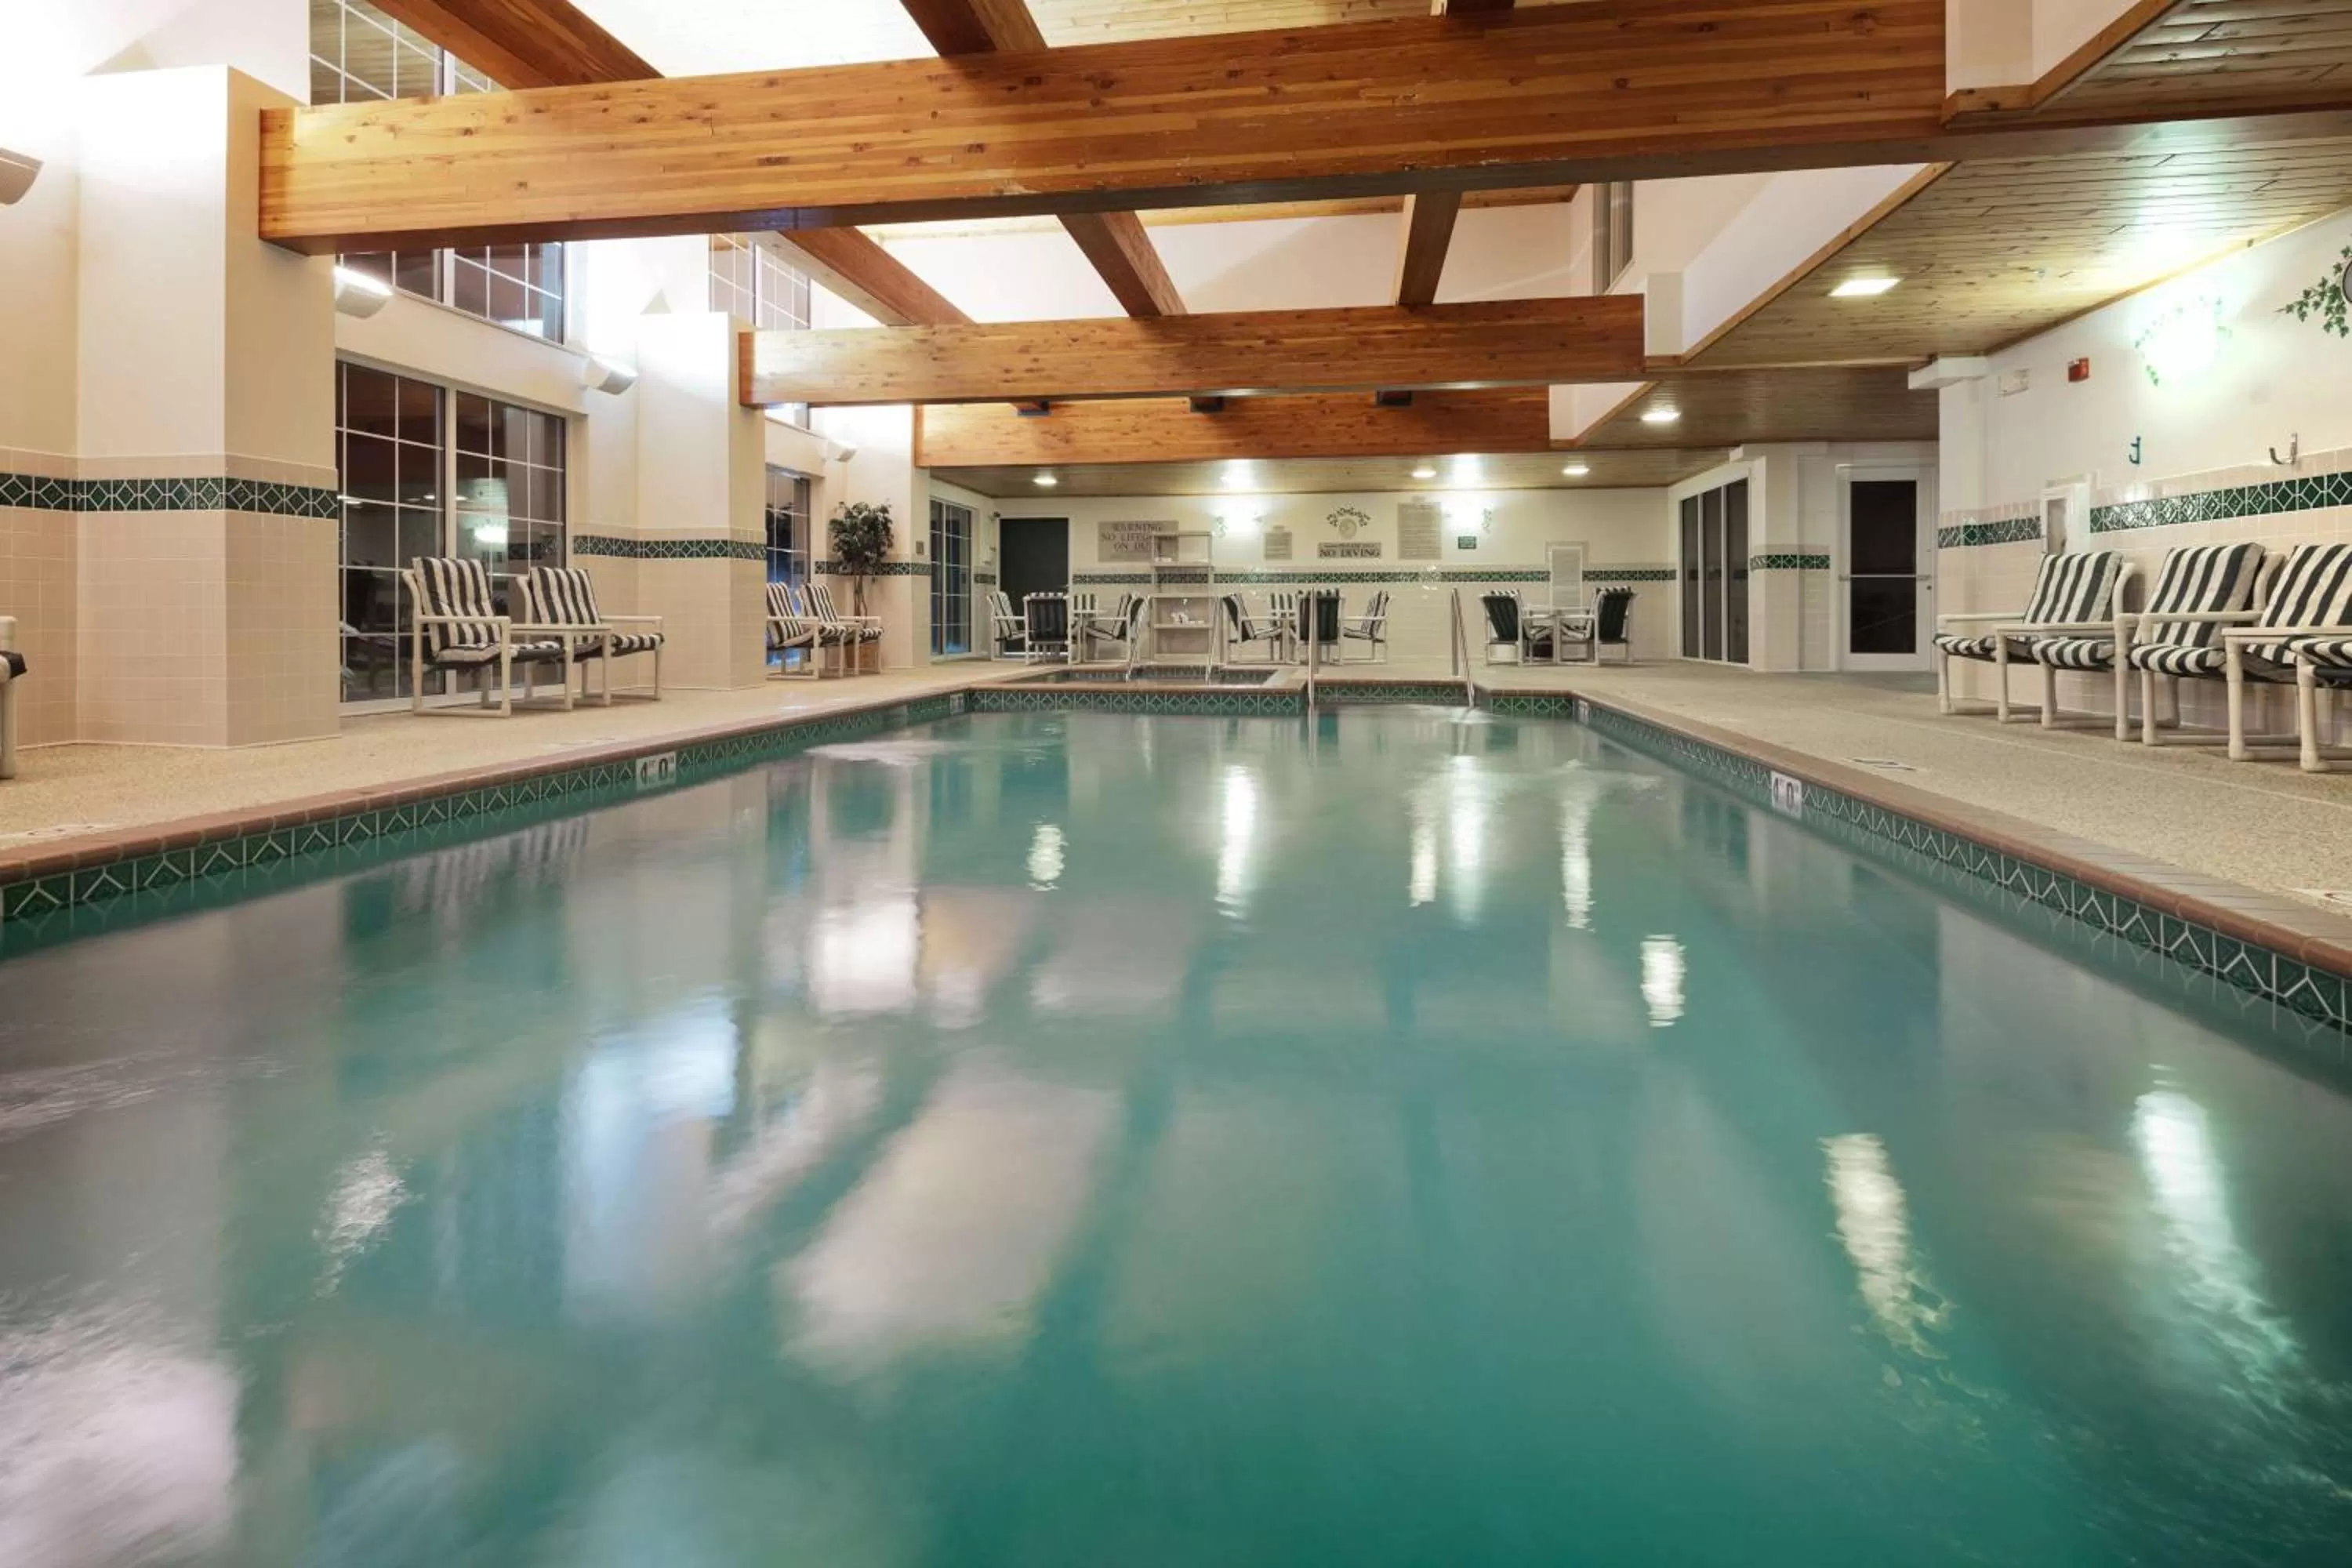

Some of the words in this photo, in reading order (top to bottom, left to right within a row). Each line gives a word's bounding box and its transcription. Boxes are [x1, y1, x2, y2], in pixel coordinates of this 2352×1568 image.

[1101, 532, 1116, 541] NO
[1113, 541, 1129, 550] ON
[1319, 549, 1336, 558] NO
[1340, 549, 1381, 558] DIVING
